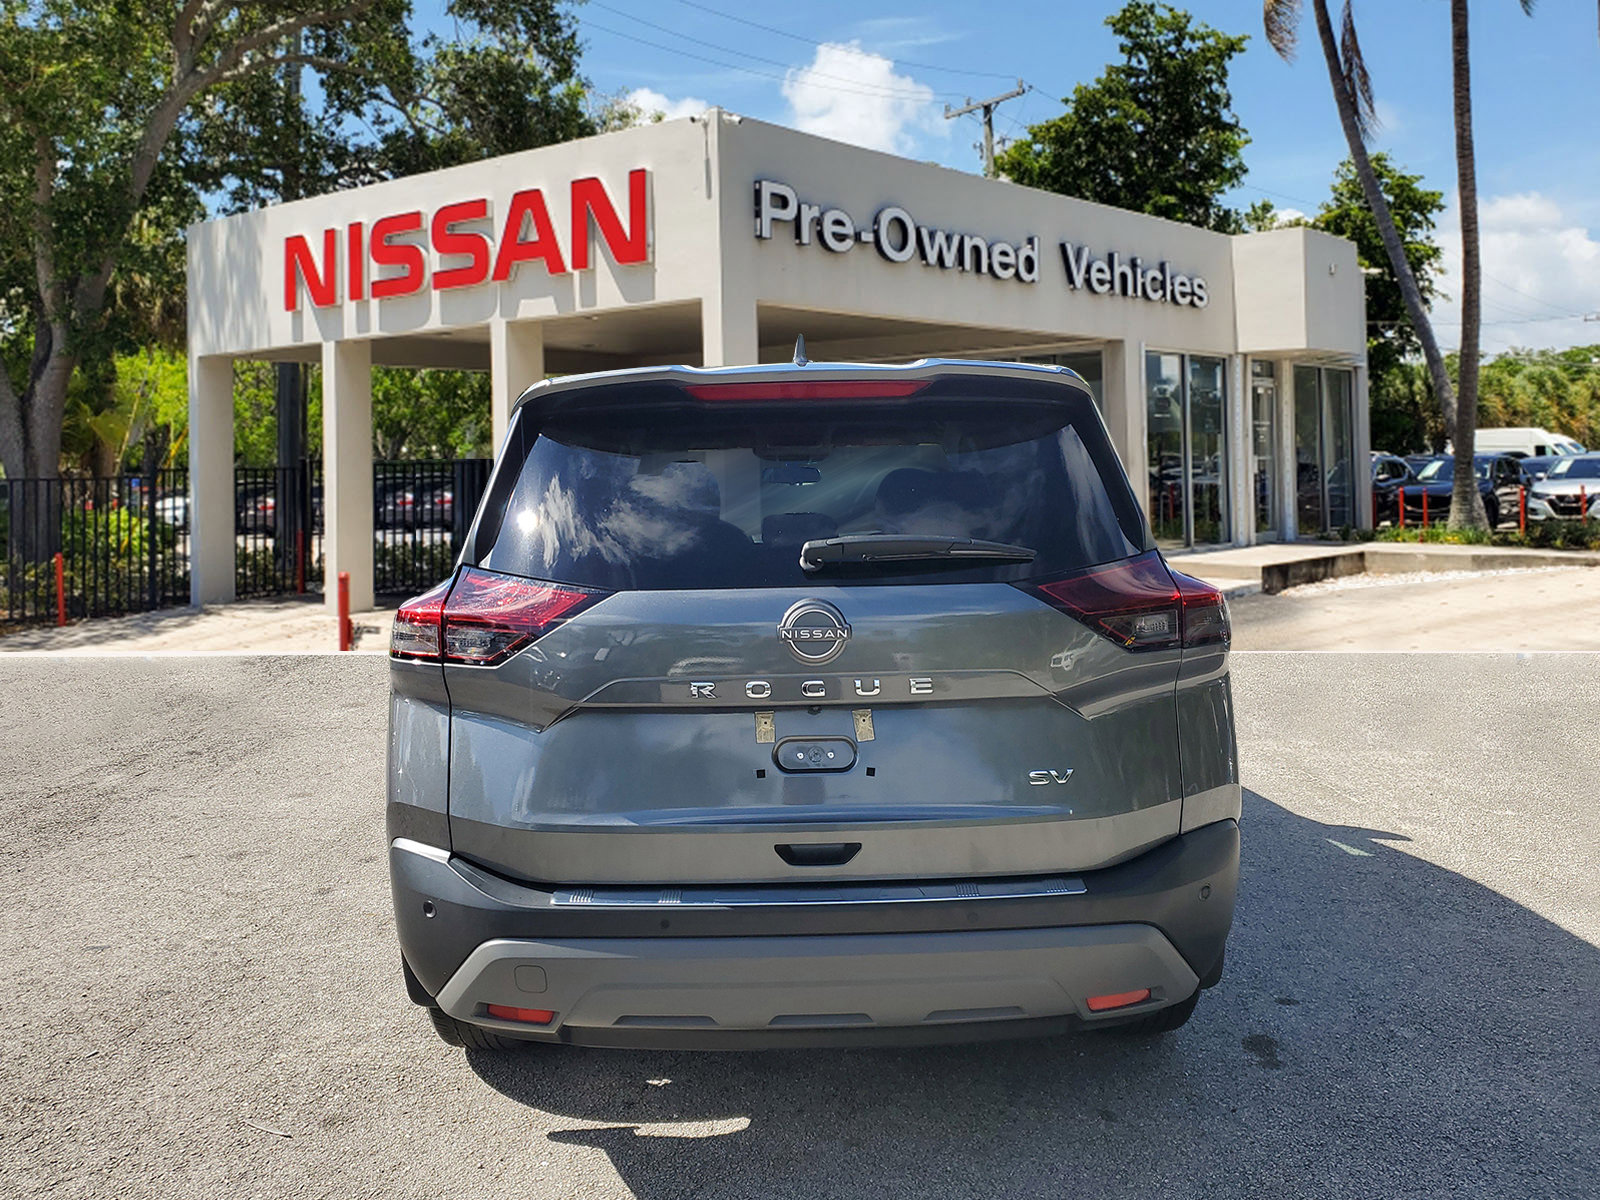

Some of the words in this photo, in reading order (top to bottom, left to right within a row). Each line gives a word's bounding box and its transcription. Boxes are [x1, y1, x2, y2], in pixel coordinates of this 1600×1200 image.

[285, 168, 648, 312] NISSAN
[754, 179, 1040, 284] Pre-Owned
[1060, 241, 1209, 309] Vehicles
[781, 629, 848, 639] NISSAN
[689, 677, 934, 699] ROGUE
[1028, 768, 1074, 785] SV
